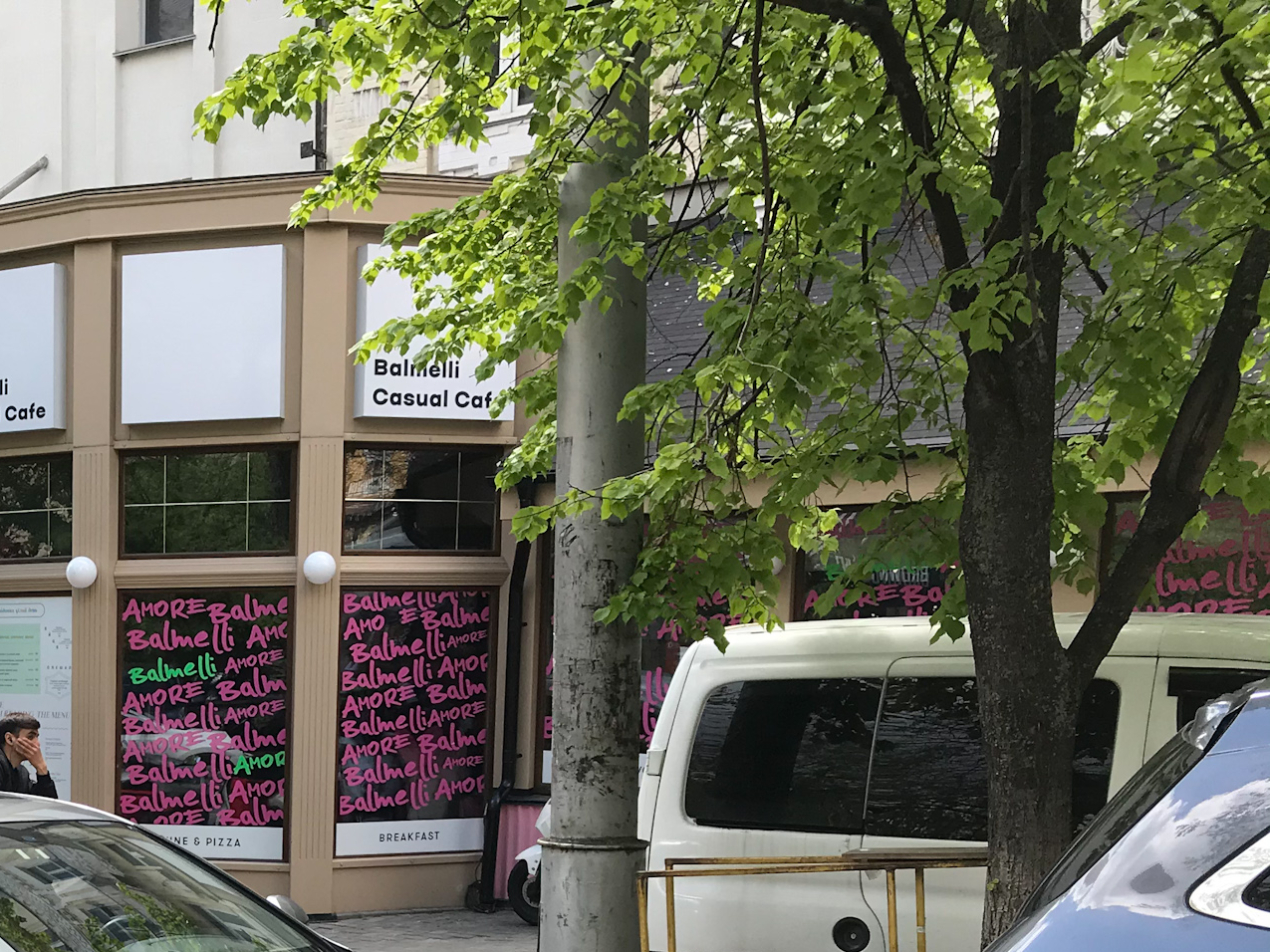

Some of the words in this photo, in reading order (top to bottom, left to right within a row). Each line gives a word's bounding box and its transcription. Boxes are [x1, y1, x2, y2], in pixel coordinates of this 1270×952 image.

[374, 358, 459, 378] Balmelli
[5, 402, 46, 421] Cafe
[372, 388, 448, 408] Casual
[455, 391, 492, 408] Caf
[122, 598, 207, 623] AMORE
[126, 620, 234, 654] Balmelli
[349, 629, 447, 663] Balmelli
[447, 630, 487, 648] AMORE
[128, 652, 217, 684] Balmelli
[224, 649, 284, 674] AMORE
[342, 656, 432, 691] Balmelli
[122, 681, 205, 714] AMORE
[216, 667, 287, 701] Balm
[342, 684, 416, 718] AMORE
[426, 671, 487, 704] Balm
[122, 702, 221, 735] Balmelli
[224, 699, 286, 725] AMORE
[341, 705, 427, 738] Balmelli
[427, 701, 486, 727] AMORE
[122, 731, 207, 763] AMORE
[341, 733, 410, 766] AMORE
[126, 750, 233, 785] Balmelli
[343, 752, 439, 786] Balmelli
[443, 756, 484, 770] AMORE
[120, 780, 223, 813] Balmelli
[339, 779, 430, 815] Balmelli
[193, 837, 201, 846] &
[206, 837, 241, 847] PIZZA
[379, 831, 440, 842] BREAKFAST
